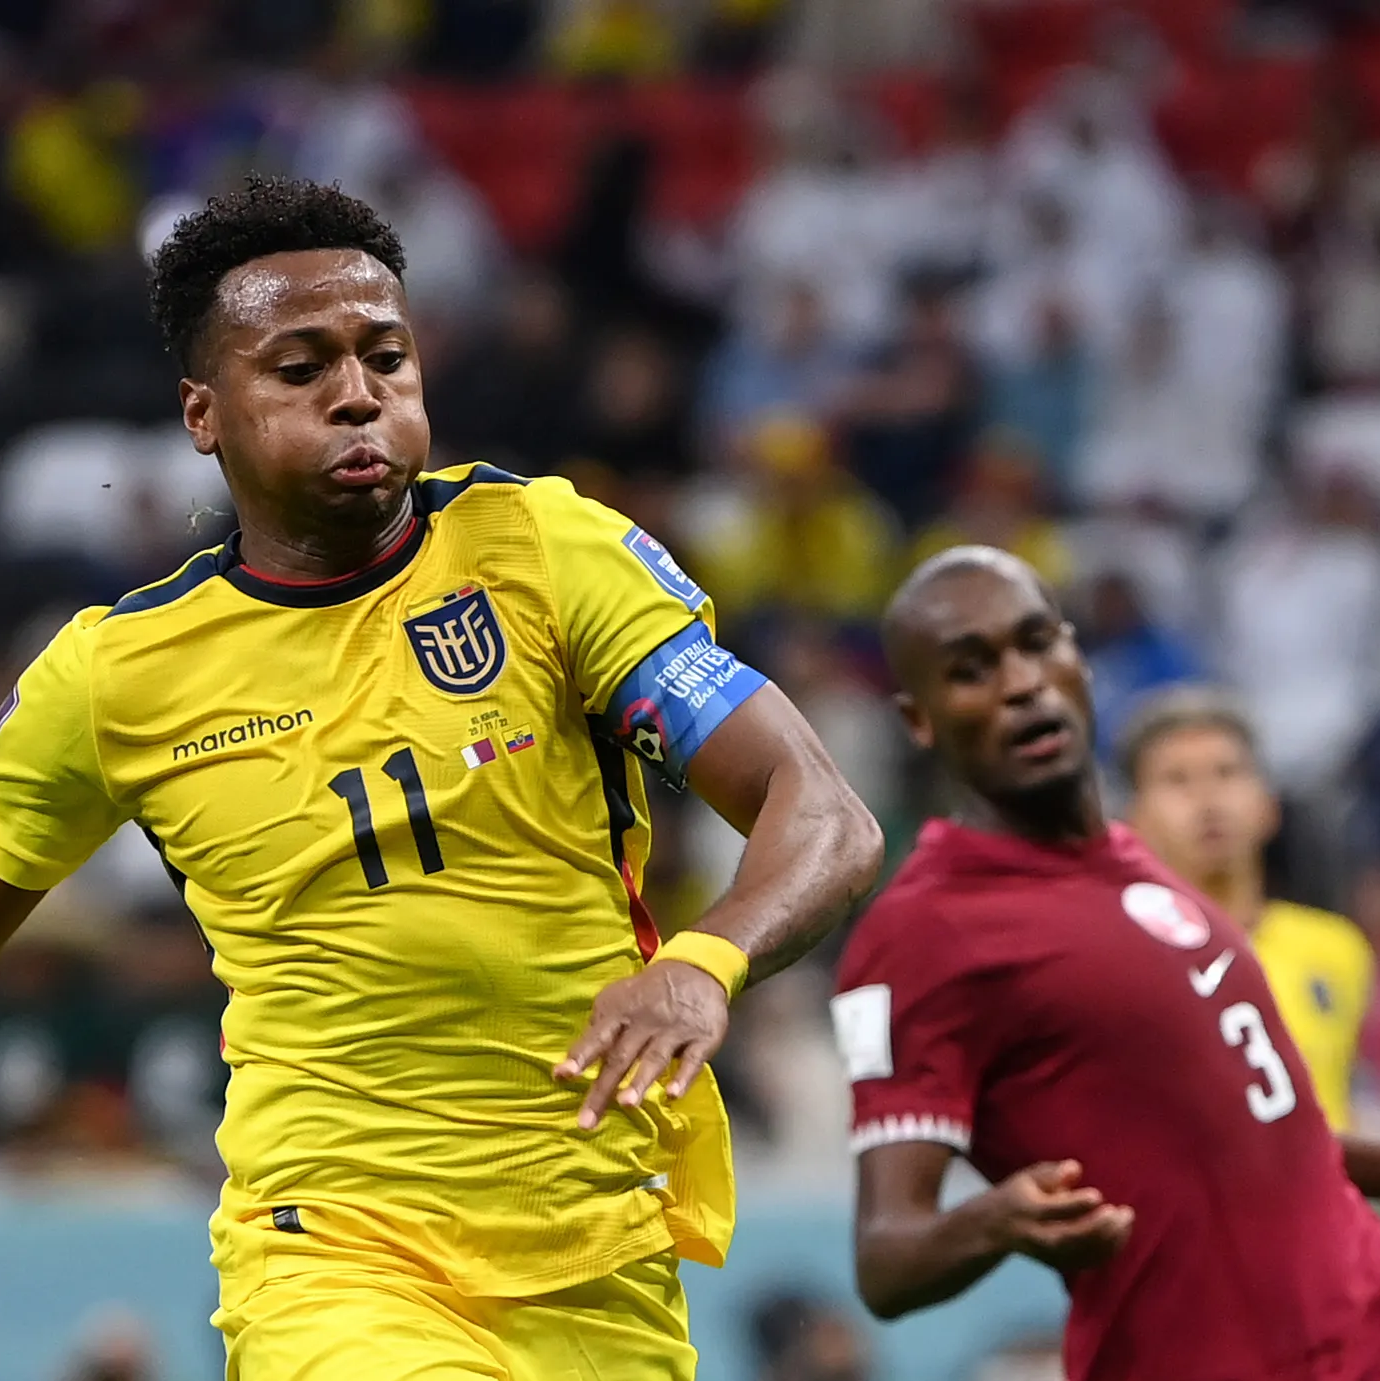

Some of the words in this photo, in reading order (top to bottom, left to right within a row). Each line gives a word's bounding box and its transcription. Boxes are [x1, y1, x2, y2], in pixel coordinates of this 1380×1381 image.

[655, 637, 712, 688] FOOTBALL
[667, 648, 730, 698] UNITES
[687, 685, 716, 709] the
[172, 708, 314, 761] marathon
[327, 746, 446, 890] 11
[1219, 1001, 1297, 1124] 3
